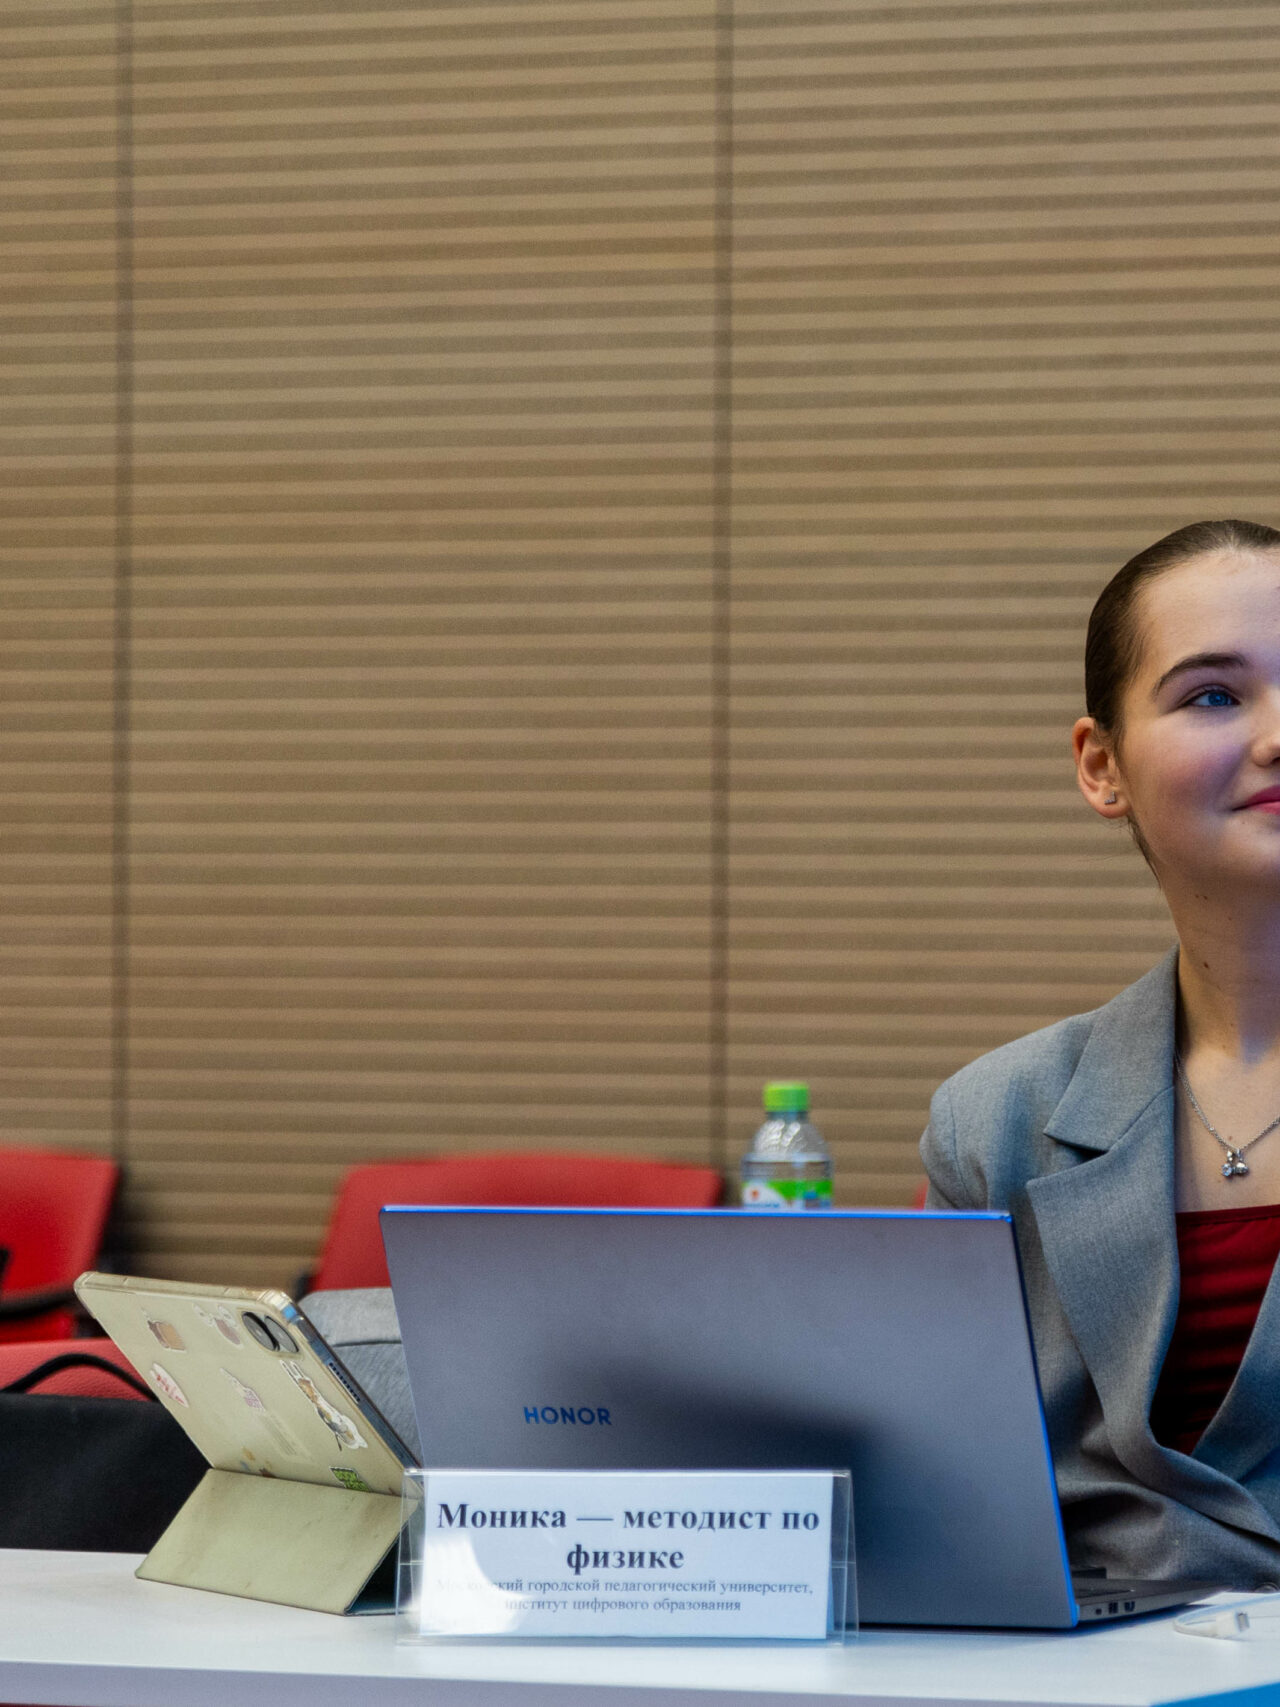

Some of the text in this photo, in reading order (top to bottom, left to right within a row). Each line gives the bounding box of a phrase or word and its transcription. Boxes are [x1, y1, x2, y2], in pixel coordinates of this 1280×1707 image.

[523, 1406, 612, 1425] HONOR
[437, 1502, 567, 1529] Моника
[623, 1510, 772, 1533] методист
[782, 1511, 820, 1531] по
[566, 1543, 685, 1576] физике
[528, 1579, 600, 1595] городской
[604, 1579, 716, 1594] педагогический
[719, 1582, 813, 1596] университет,
[573, 1597, 649, 1613] цифрового
[653, 1598, 741, 1613] образования
